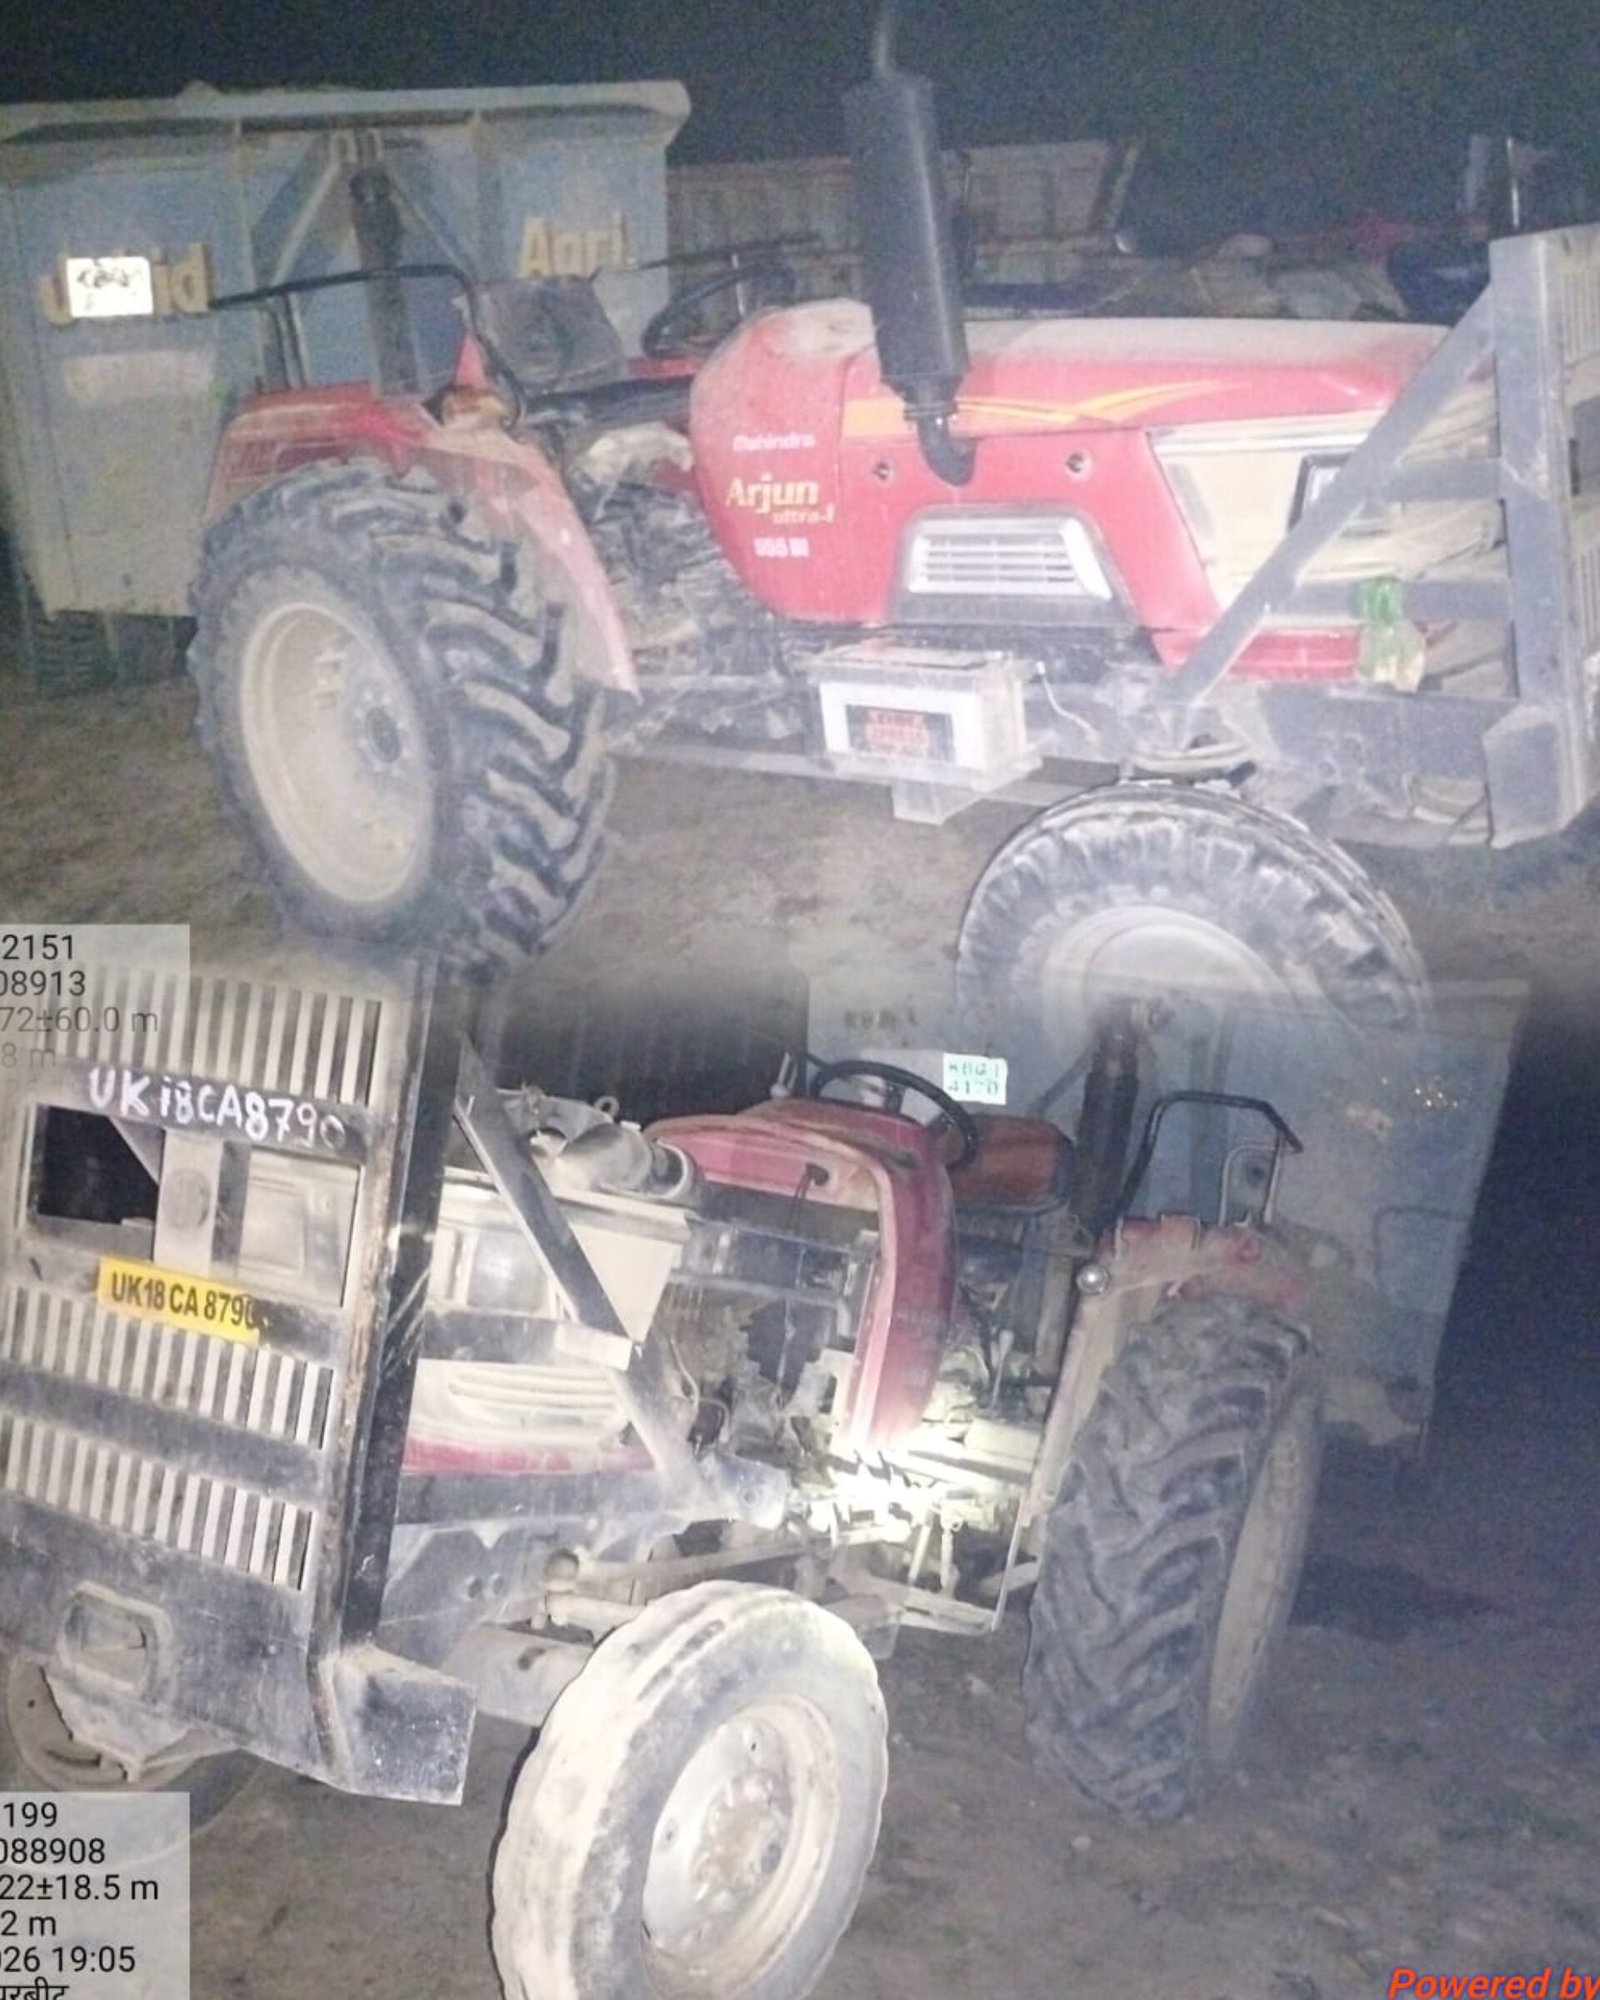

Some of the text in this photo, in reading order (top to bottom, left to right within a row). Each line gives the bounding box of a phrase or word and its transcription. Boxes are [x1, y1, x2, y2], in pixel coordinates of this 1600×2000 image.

[725, 472, 819, 514] Arjun
[110, 1271, 166, 1311] UK18
[169, 1283, 199, 1317] CA
